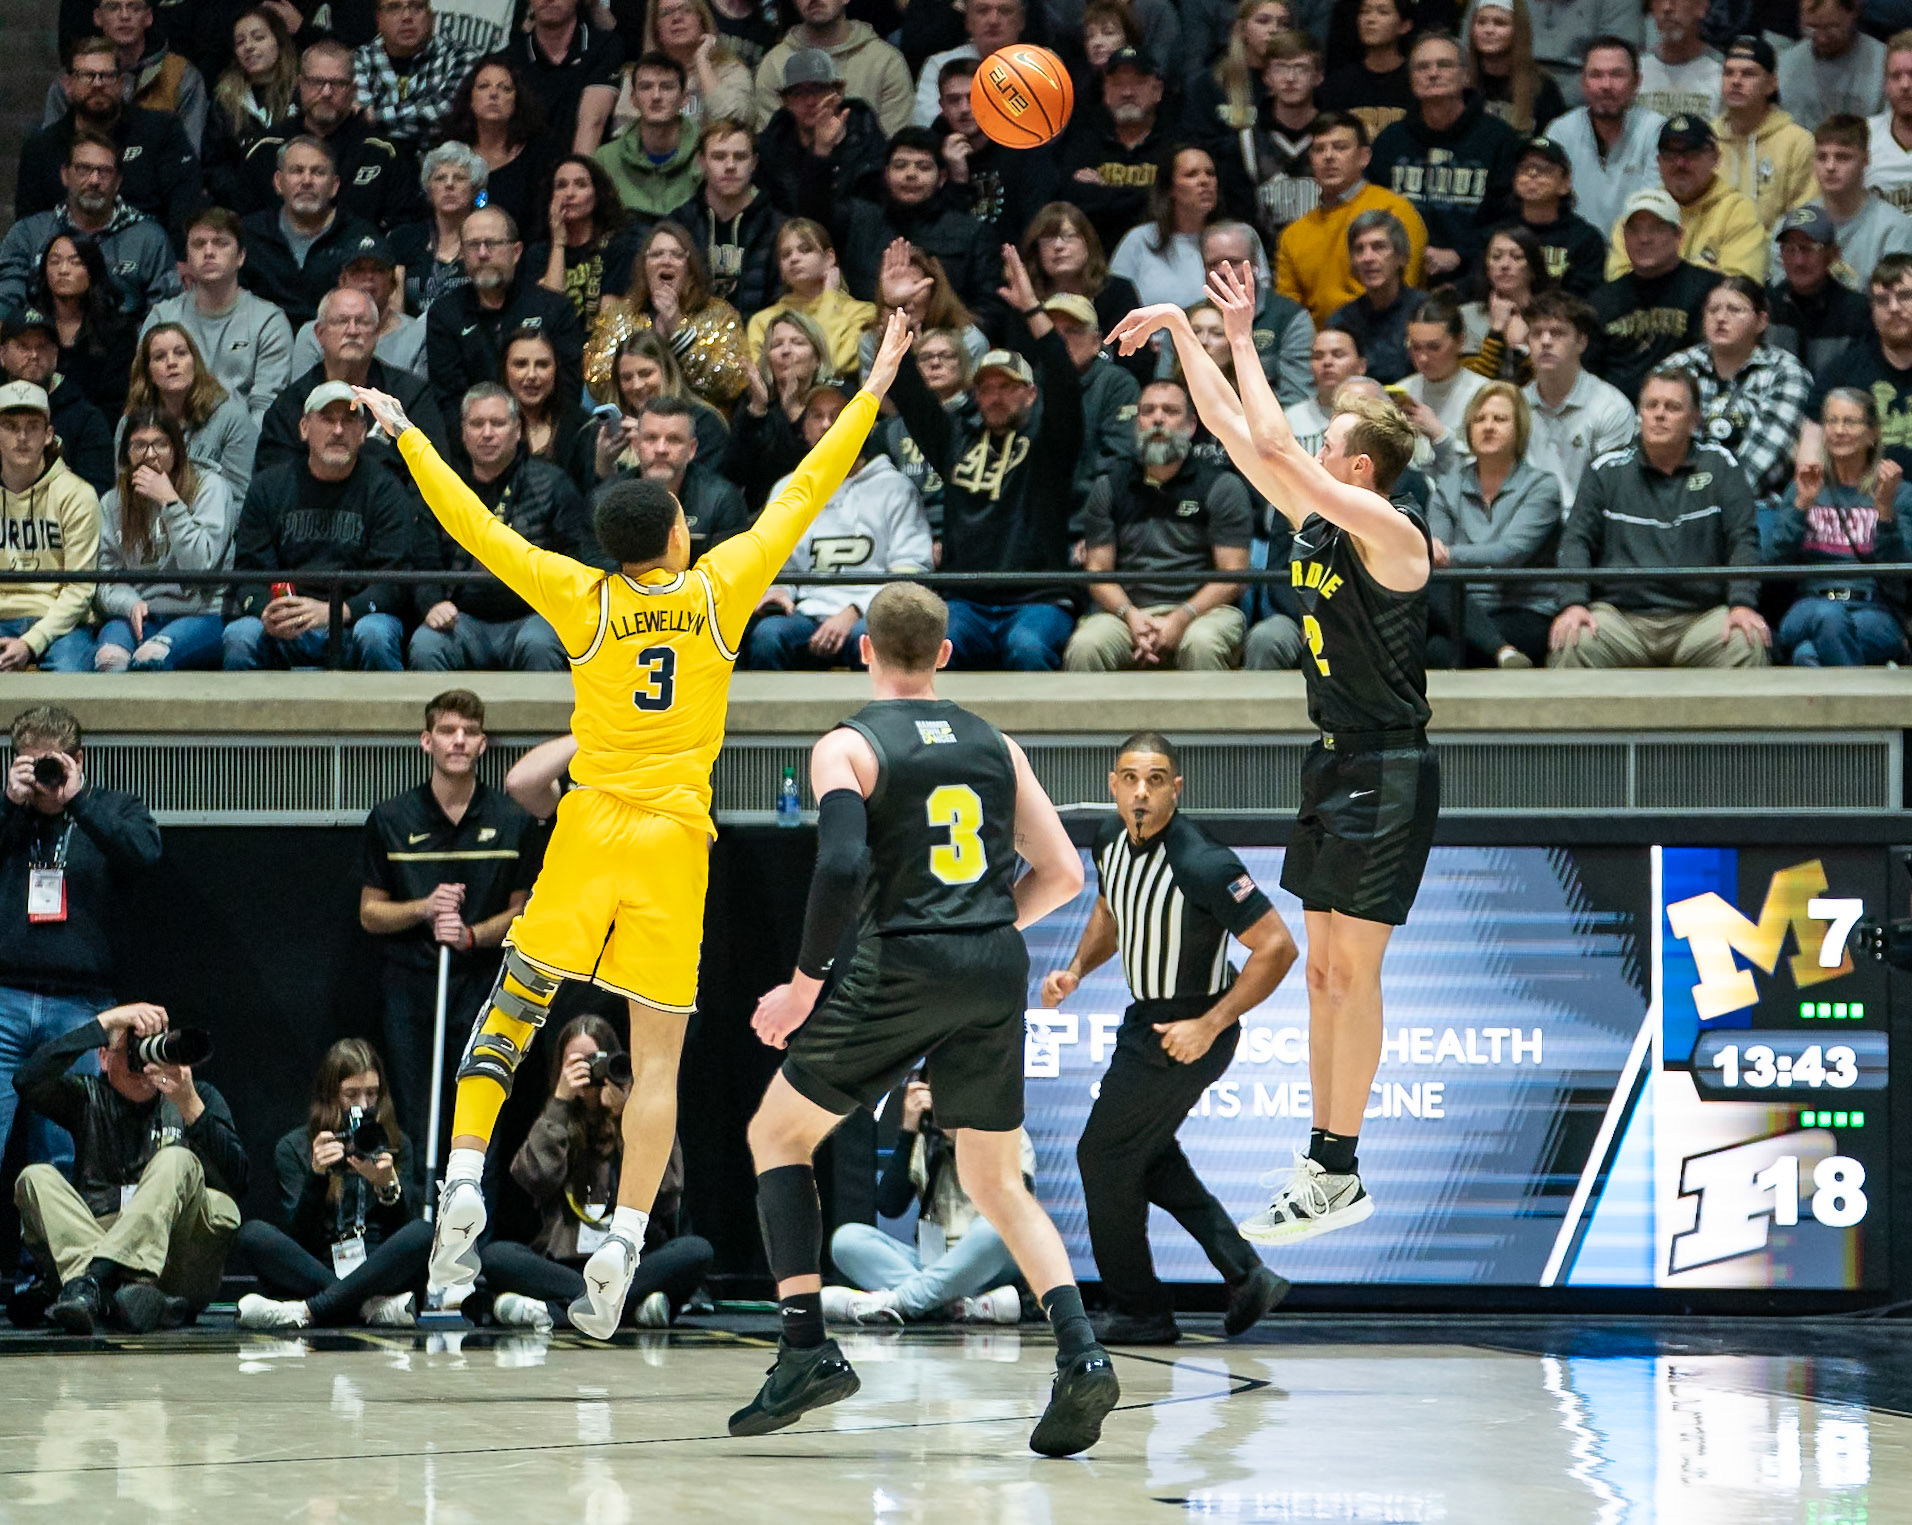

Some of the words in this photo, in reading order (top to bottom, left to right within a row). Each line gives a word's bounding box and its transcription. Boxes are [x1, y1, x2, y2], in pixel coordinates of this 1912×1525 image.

[989, 66, 1029, 113] ELITE
[610, 610, 705, 640] LLEWELLYN
[1302, 614, 1331, 676] 2
[632, 645, 678, 712] 3
[926, 784, 988, 885] 3
[1807, 898, 1864, 968] 7
[1380, 1027, 1543, 1064] HEALTH
[1713, 1045, 1859, 1088] 13:43
[1254, 1082, 1446, 1119] MECINE
[1756, 1155, 1868, 1228] 18
